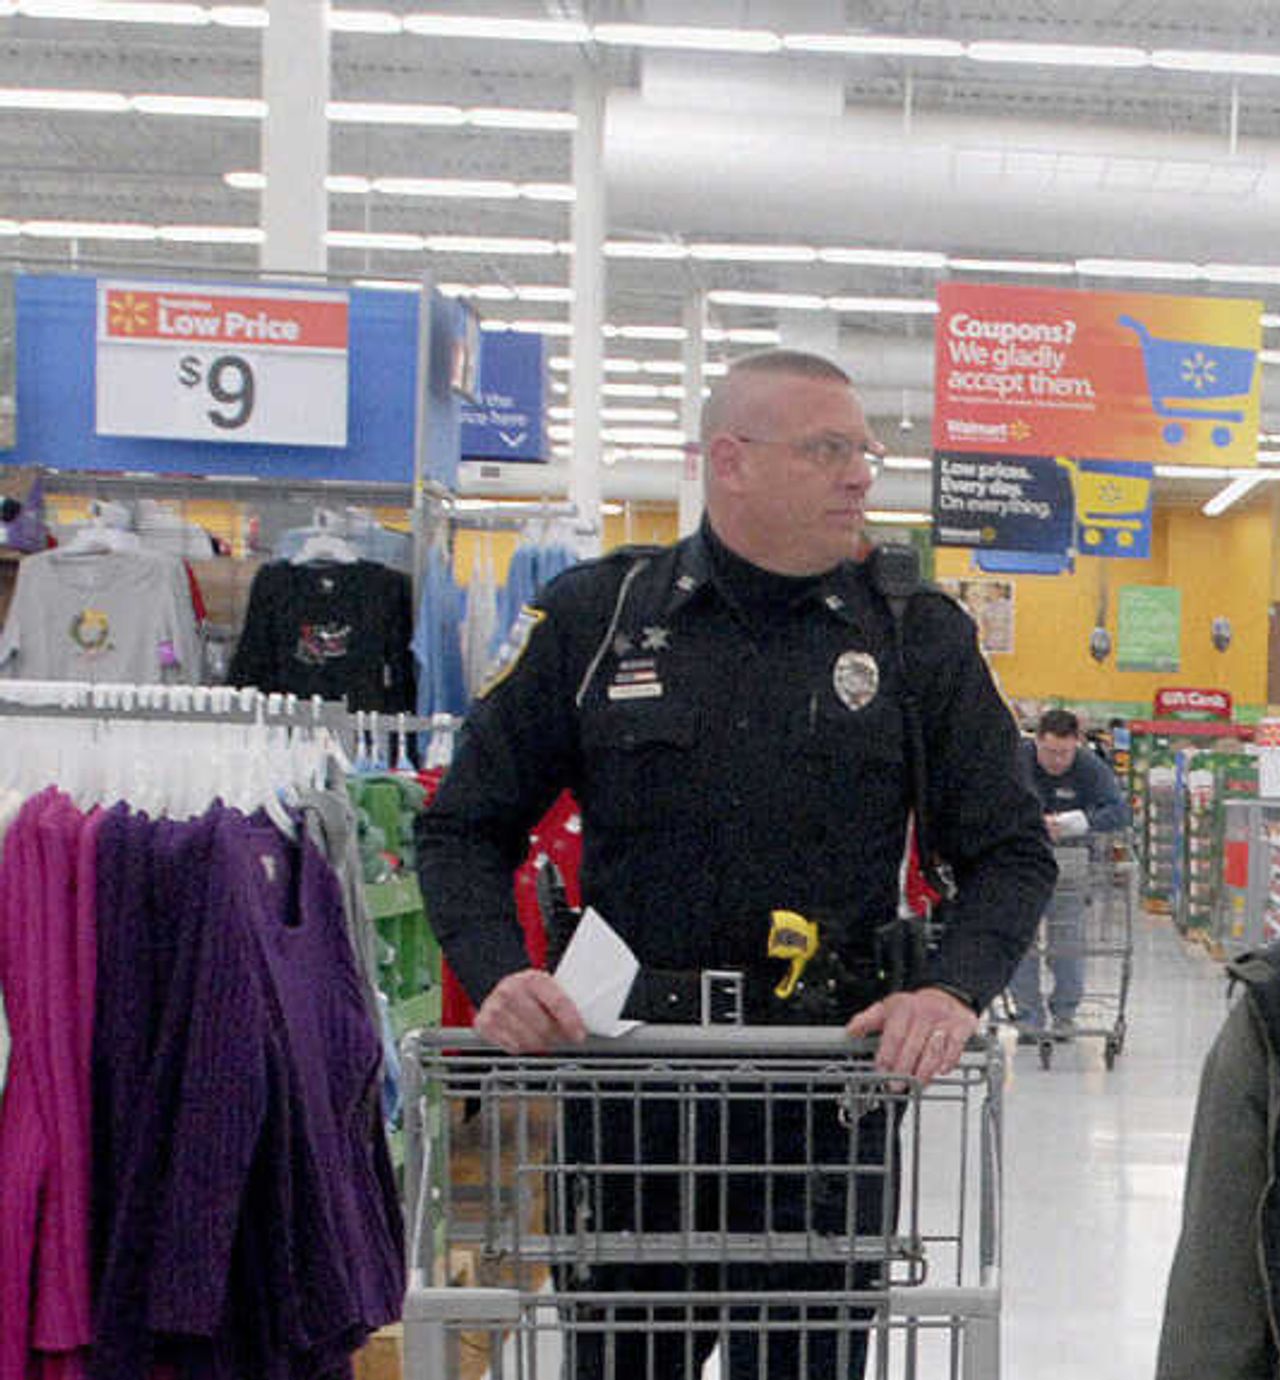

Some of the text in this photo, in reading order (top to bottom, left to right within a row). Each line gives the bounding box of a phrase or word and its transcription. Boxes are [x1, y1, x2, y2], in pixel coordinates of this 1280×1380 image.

[157, 300, 219, 336] Low
[225, 312, 300, 341] Price
[950, 313, 1077, 345] Coupons?
[949, 340, 1067, 374] We gladly
[949, 370, 1096, 401] accept them.
[941, 460, 976, 477] Low
[941, 476, 986, 498] Every
